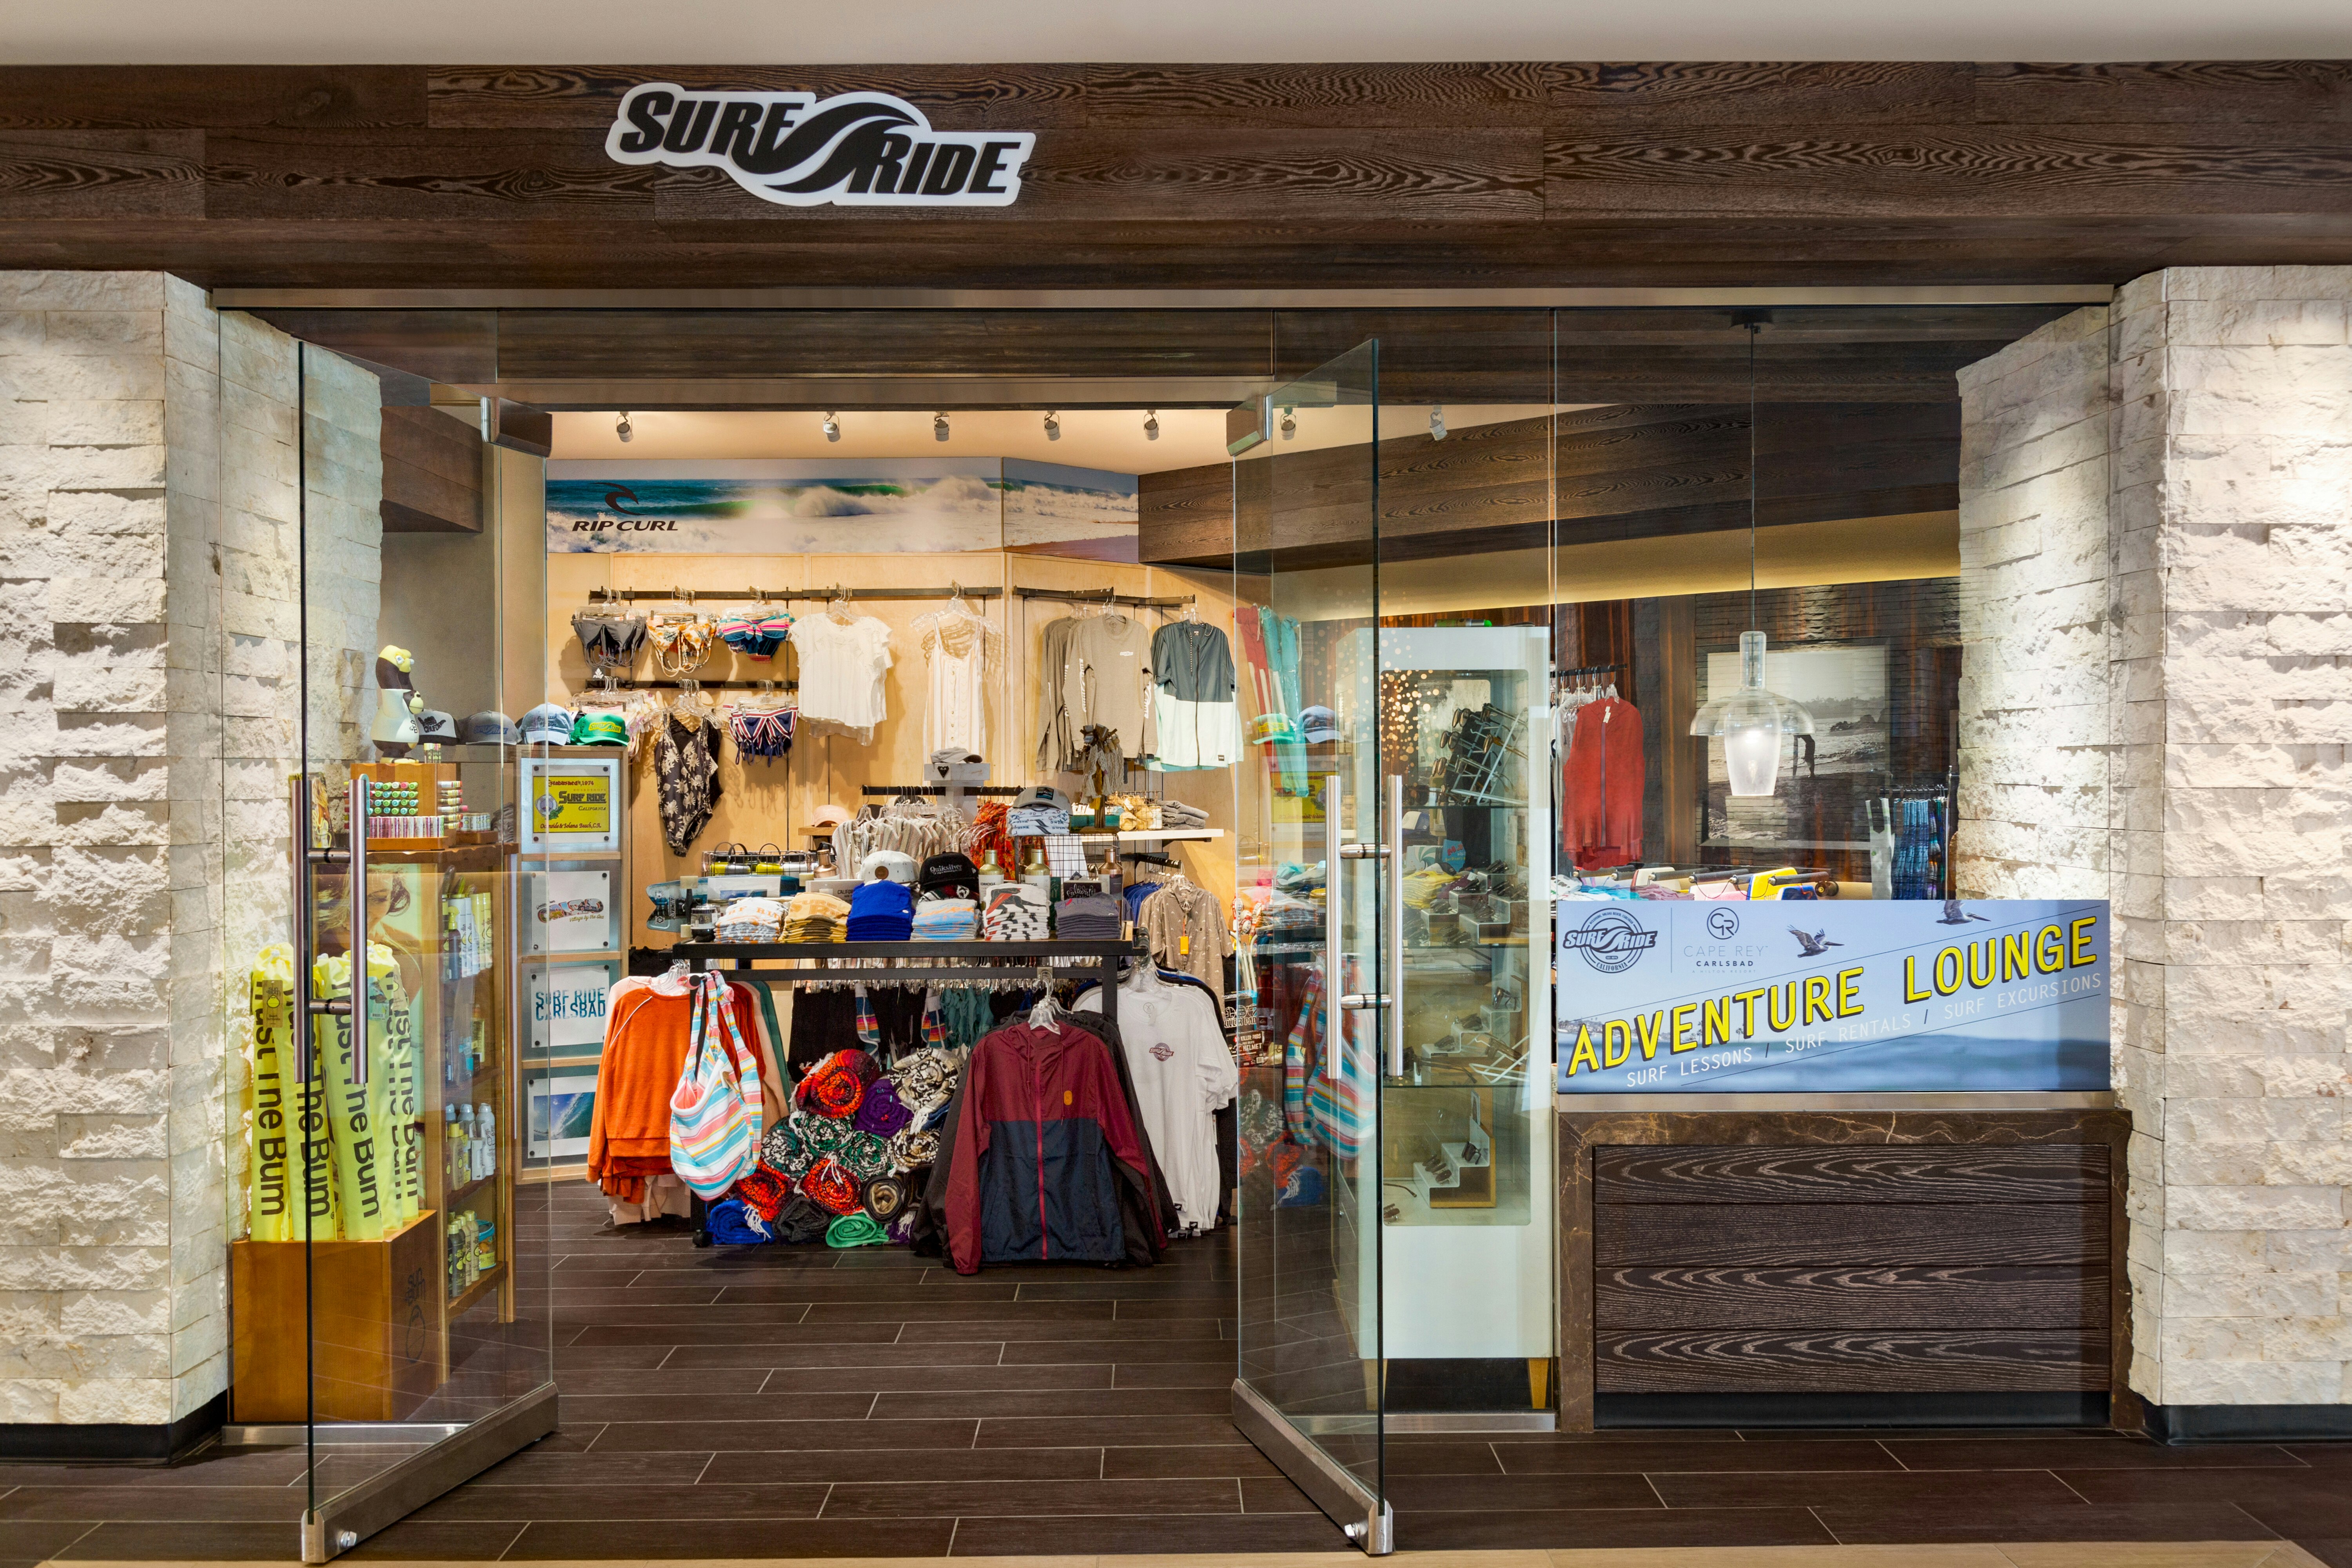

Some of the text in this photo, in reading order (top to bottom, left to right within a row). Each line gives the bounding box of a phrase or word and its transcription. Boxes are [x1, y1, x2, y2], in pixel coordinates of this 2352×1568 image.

[619, 91, 1022, 195] SURF RIDE
[572, 521, 678, 531] RIP CURL
[559, 791, 606, 804] SURF RIDE
[930, 864, 962, 874] Quiksilver
[1564, 930, 1655, 950] SURF RIDE
[1684, 946, 1726, 957] CAPE
[1596, 962, 1628, 971] CALIFORNIA
[536, 987, 606, 1005] SURF RIDE
[1566, 916, 2097, 1078] ADVENTURE LOUNGE
[536, 1002, 606, 1021] CARLSBAD
[1627, 1065, 1668, 1087] SURF
[1681, 1047, 1753, 1076] LESSONS
[1786, 1031, 1827, 1053] SURF
[1839, 1013, 1911, 1042] RENTALS
[1944, 997, 1985, 1020] SURF
[1998, 973, 2102, 1008] EXCURSIONS
[1243, 1043, 1262, 1051] HELMET
[260, 1137, 287, 1216] Bum
[300, 1137, 330, 1217] Bum
[354, 1137, 380, 1218] Bum
